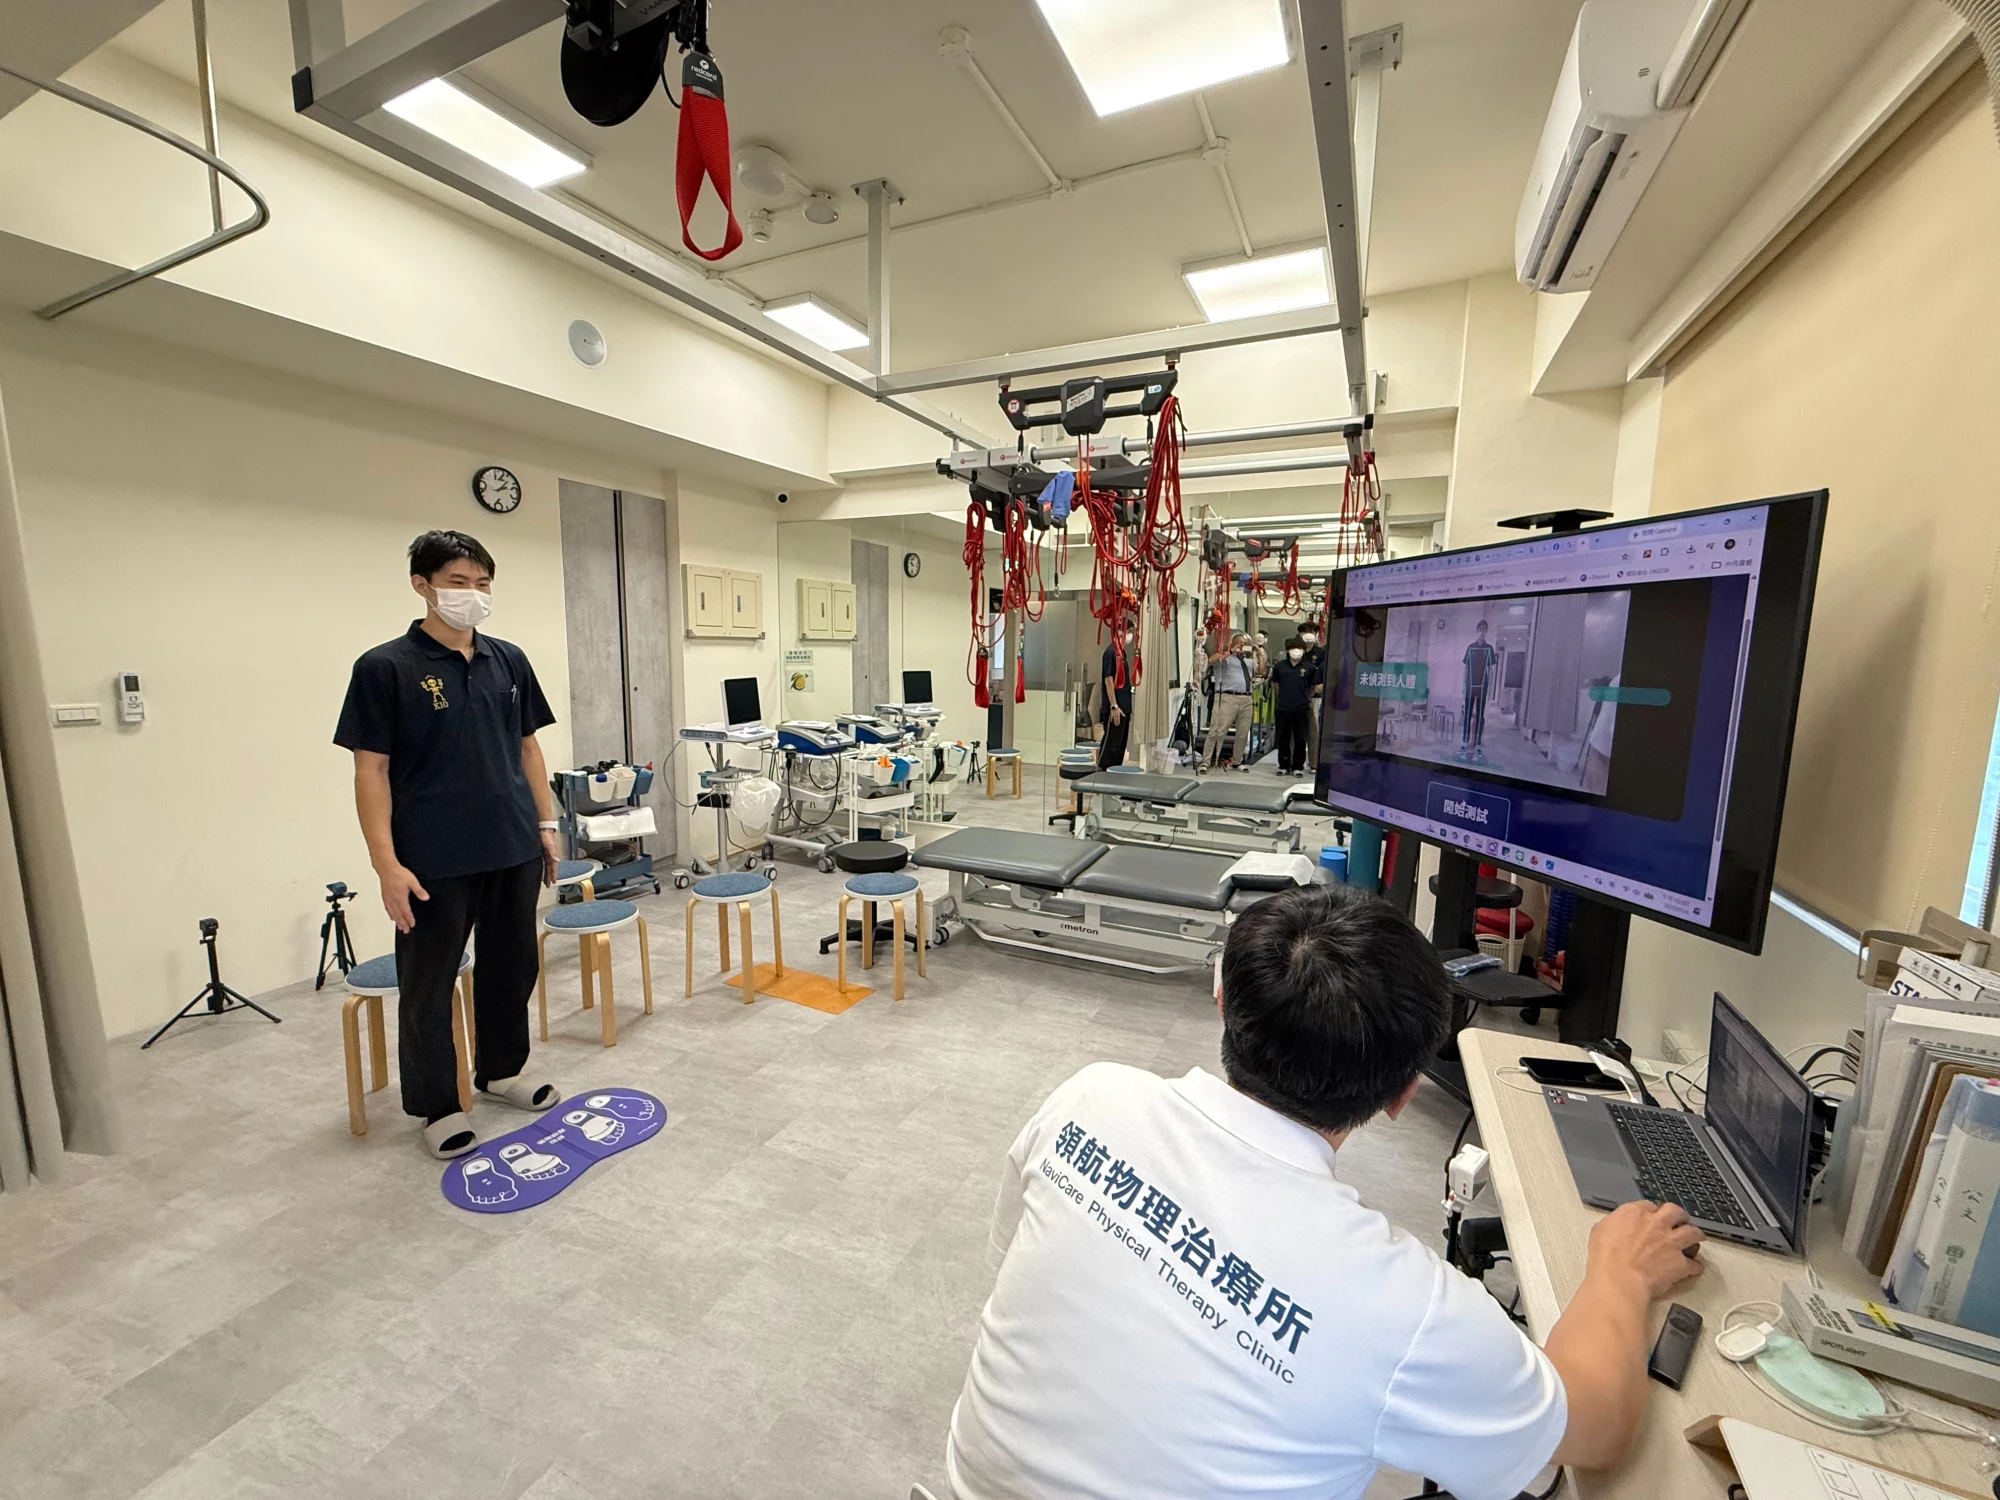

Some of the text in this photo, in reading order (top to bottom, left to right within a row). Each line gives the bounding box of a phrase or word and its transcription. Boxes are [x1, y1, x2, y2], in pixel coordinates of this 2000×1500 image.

[691, 65, 717, 80] redcord
[1359, 672, 1417, 689] 未偵測到人體
[1443, 799, 1489, 825] 開始測試
[1064, 923, 1099, 935] metron
[1055, 1120, 1313, 1354] 領航物理治療所
[1039, 1158, 1295, 1384] NaviCare Physical Therapy Clinic
